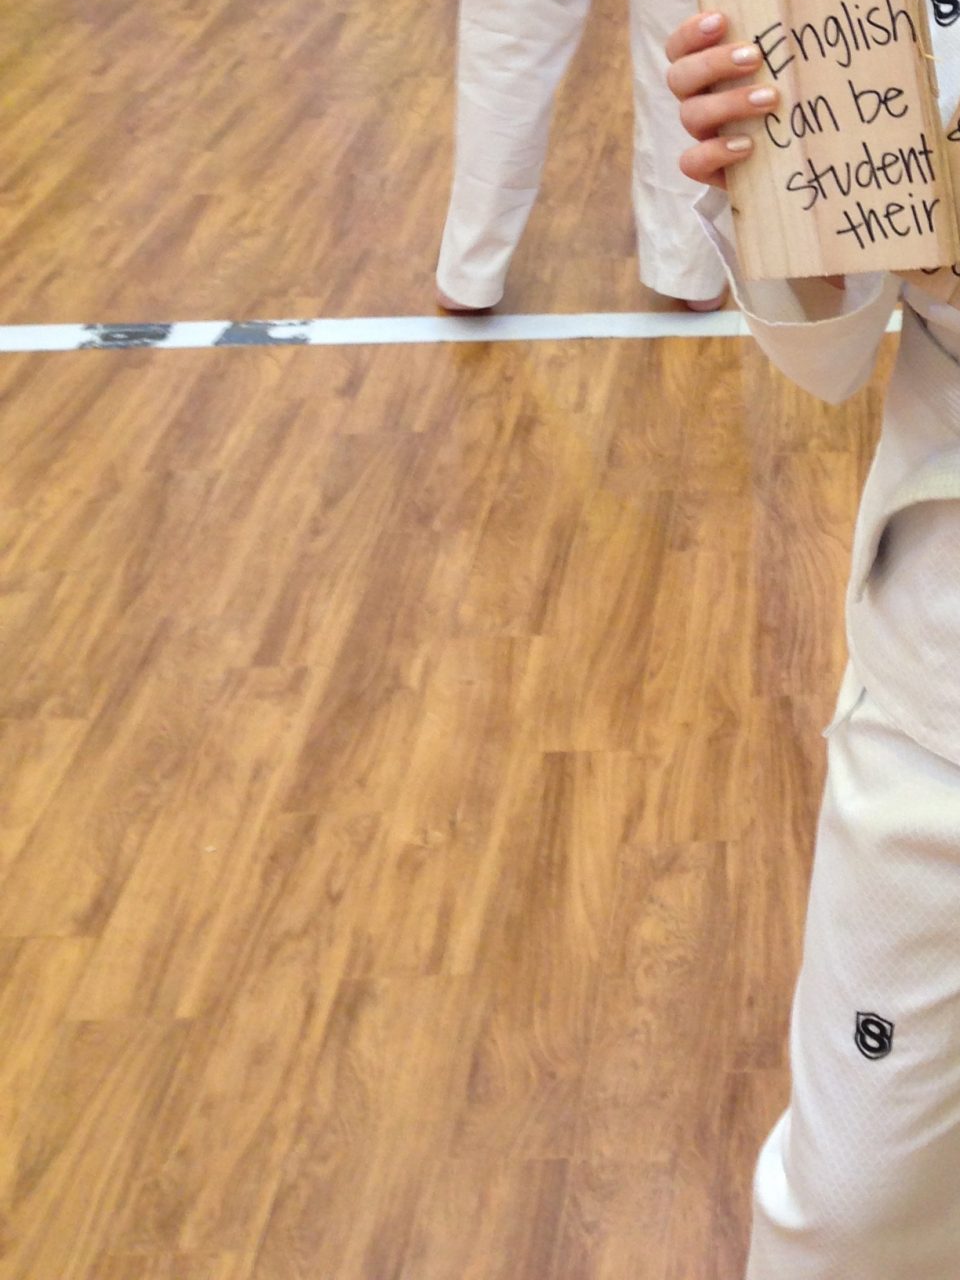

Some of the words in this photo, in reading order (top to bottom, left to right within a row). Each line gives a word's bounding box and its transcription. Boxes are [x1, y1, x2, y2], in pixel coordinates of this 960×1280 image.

[763, 94, 841, 149] can
[847, 78, 909, 125] be
[785, 132, 936, 211] student
[835, 192, 941, 251] their
